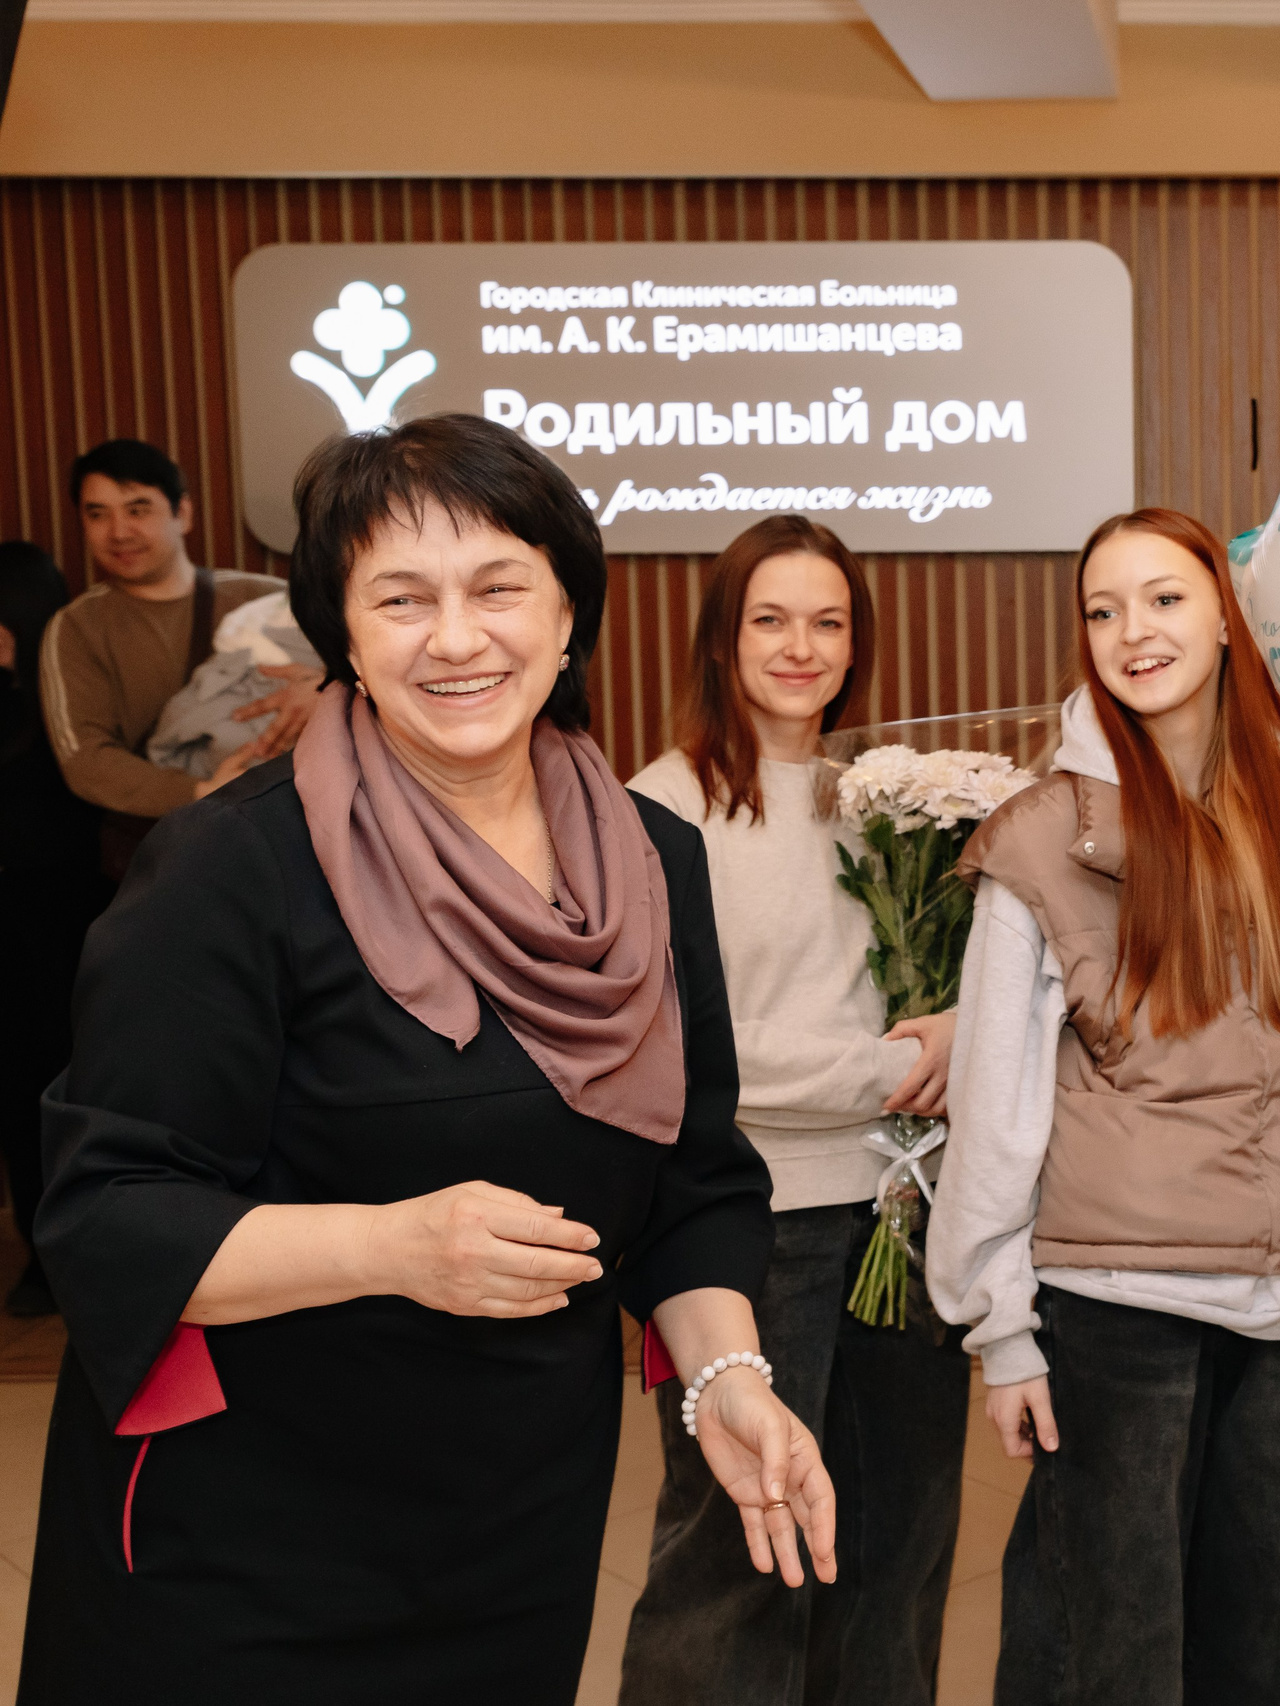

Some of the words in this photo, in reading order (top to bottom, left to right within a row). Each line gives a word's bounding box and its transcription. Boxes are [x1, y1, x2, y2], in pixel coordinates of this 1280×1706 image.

[480, 282, 628, 312] Городская
[632, 281, 815, 307] Клиническая
[820, 279, 957, 308] Больница
[482, 324, 552, 353] им.
[558, 316, 599, 353] А.
[606, 316, 646, 352] К.
[653, 315, 962, 360] Ерамишанцева
[483, 388, 868, 454] Родильный
[885, 400, 1026, 451] дом
[598, 472, 857, 526] рождается
[857, 485, 993, 524] жизнь
